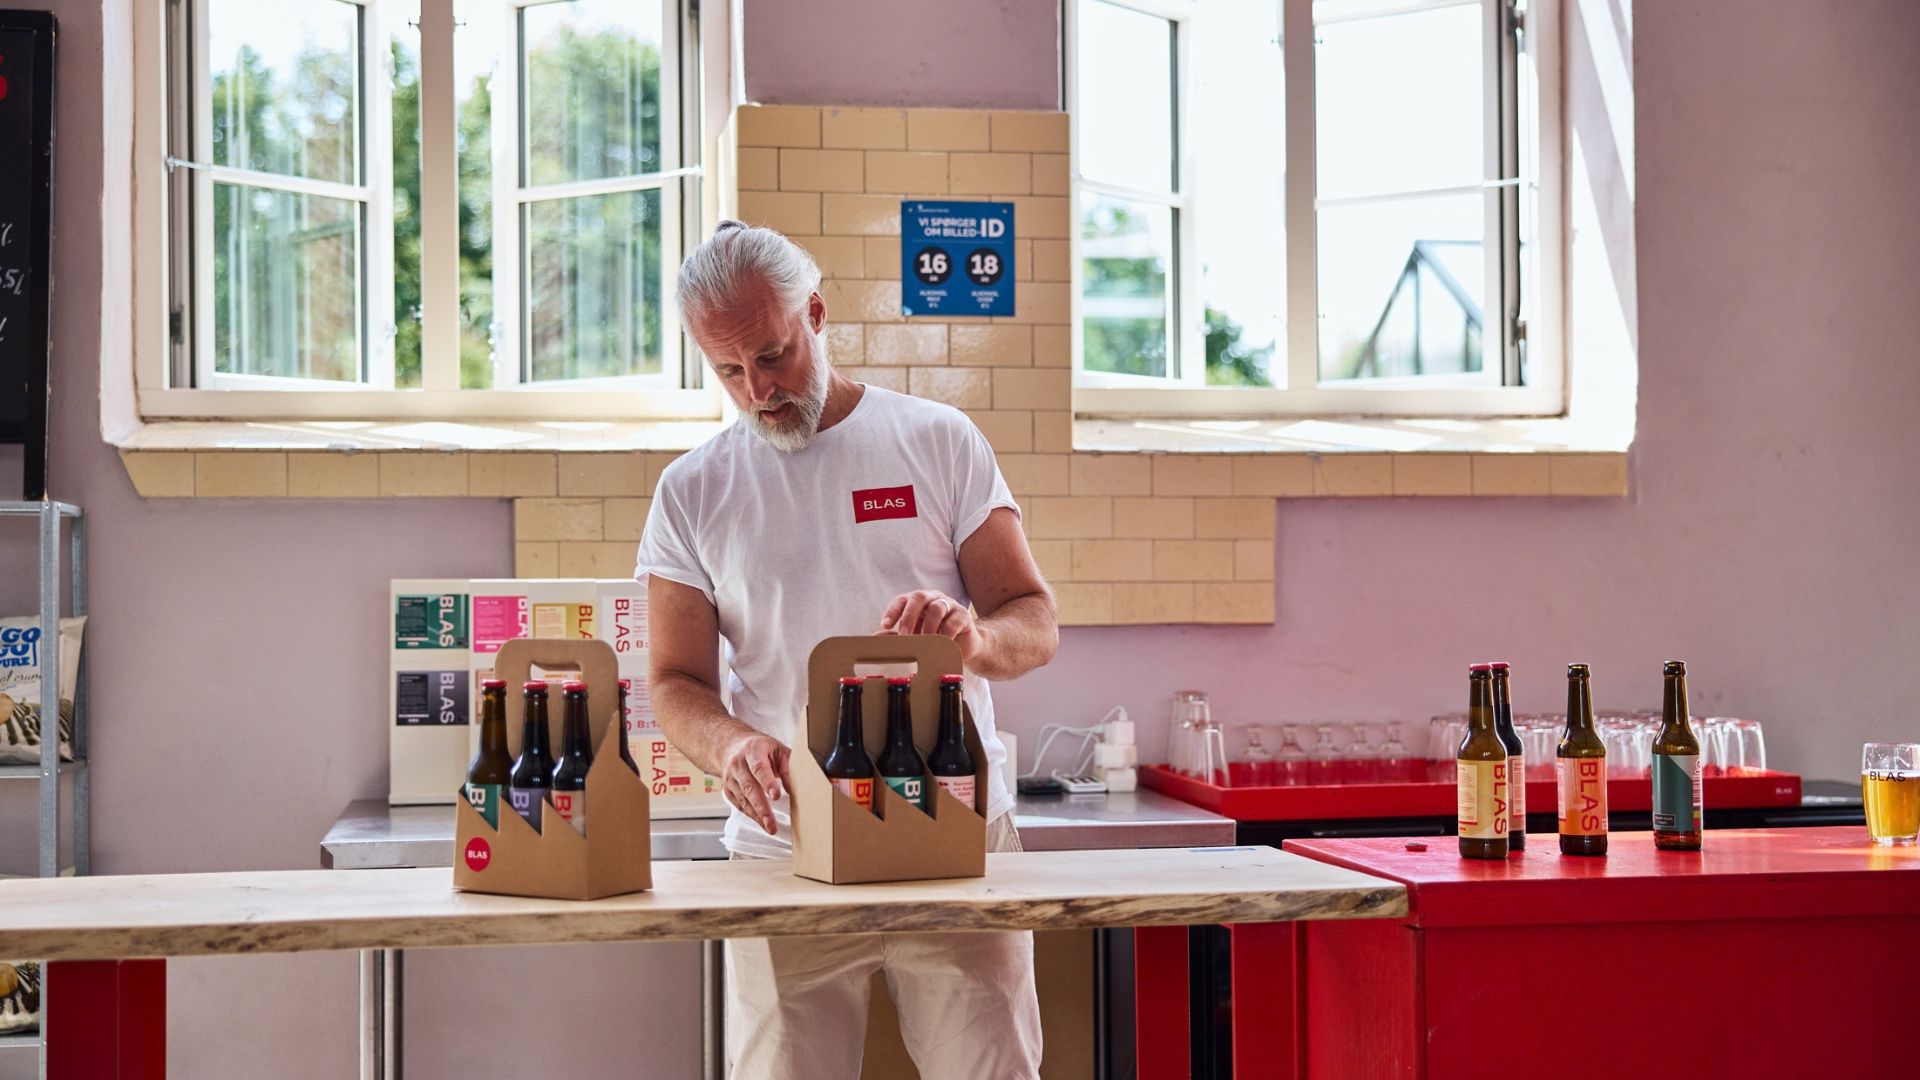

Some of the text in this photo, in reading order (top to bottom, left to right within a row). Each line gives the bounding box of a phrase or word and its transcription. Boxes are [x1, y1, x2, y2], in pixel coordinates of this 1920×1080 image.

[918, 217, 929, 227] VI
[924, 227, 941, 237] OM
[919, 253, 948, 274] 16
[971, 254, 999, 275] 18
[863, 498, 906, 511] BLAS
[439, 596, 455, 648] BLAS
[517, 597, 528, 638] BLA
[578, 604, 593, 640] BLA
[615, 599, 631, 653] BLAS
[440, 672, 455, 724] BLAS
[651, 741, 667, 796] BLAS
[1869, 771, 1906, 782] BLAS
[1494, 764, 1507, 835] BLAS
[1579, 761, 1600, 832] BLAS
[468, 850, 488, 860] BLAS
